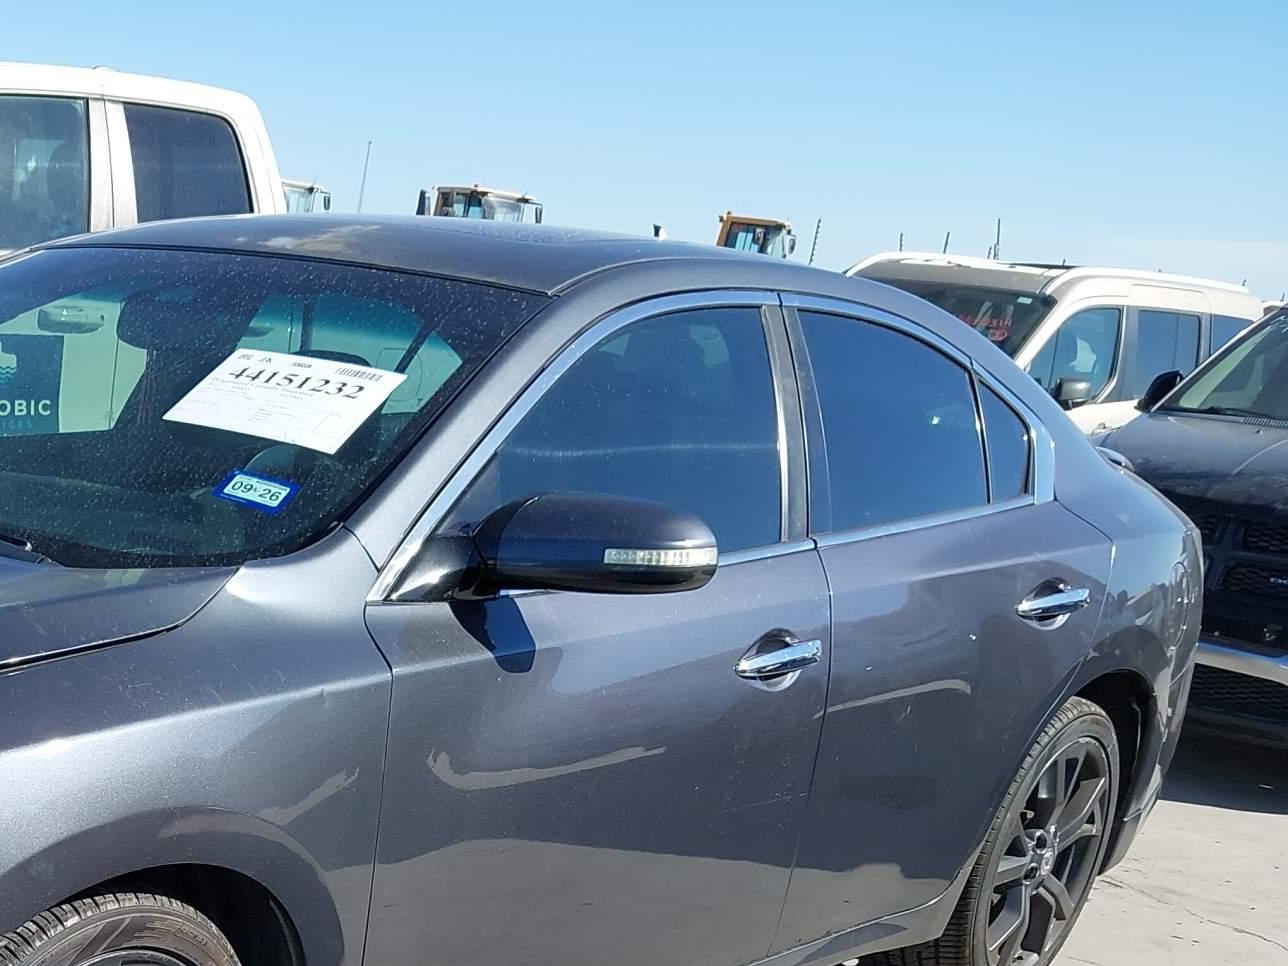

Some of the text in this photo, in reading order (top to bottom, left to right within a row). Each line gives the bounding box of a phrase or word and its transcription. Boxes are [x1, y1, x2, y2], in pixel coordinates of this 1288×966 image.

[229, 366, 365, 400] 44151232
[231, 480, 253, 494] 09
[258, 488, 283, 502] 26
